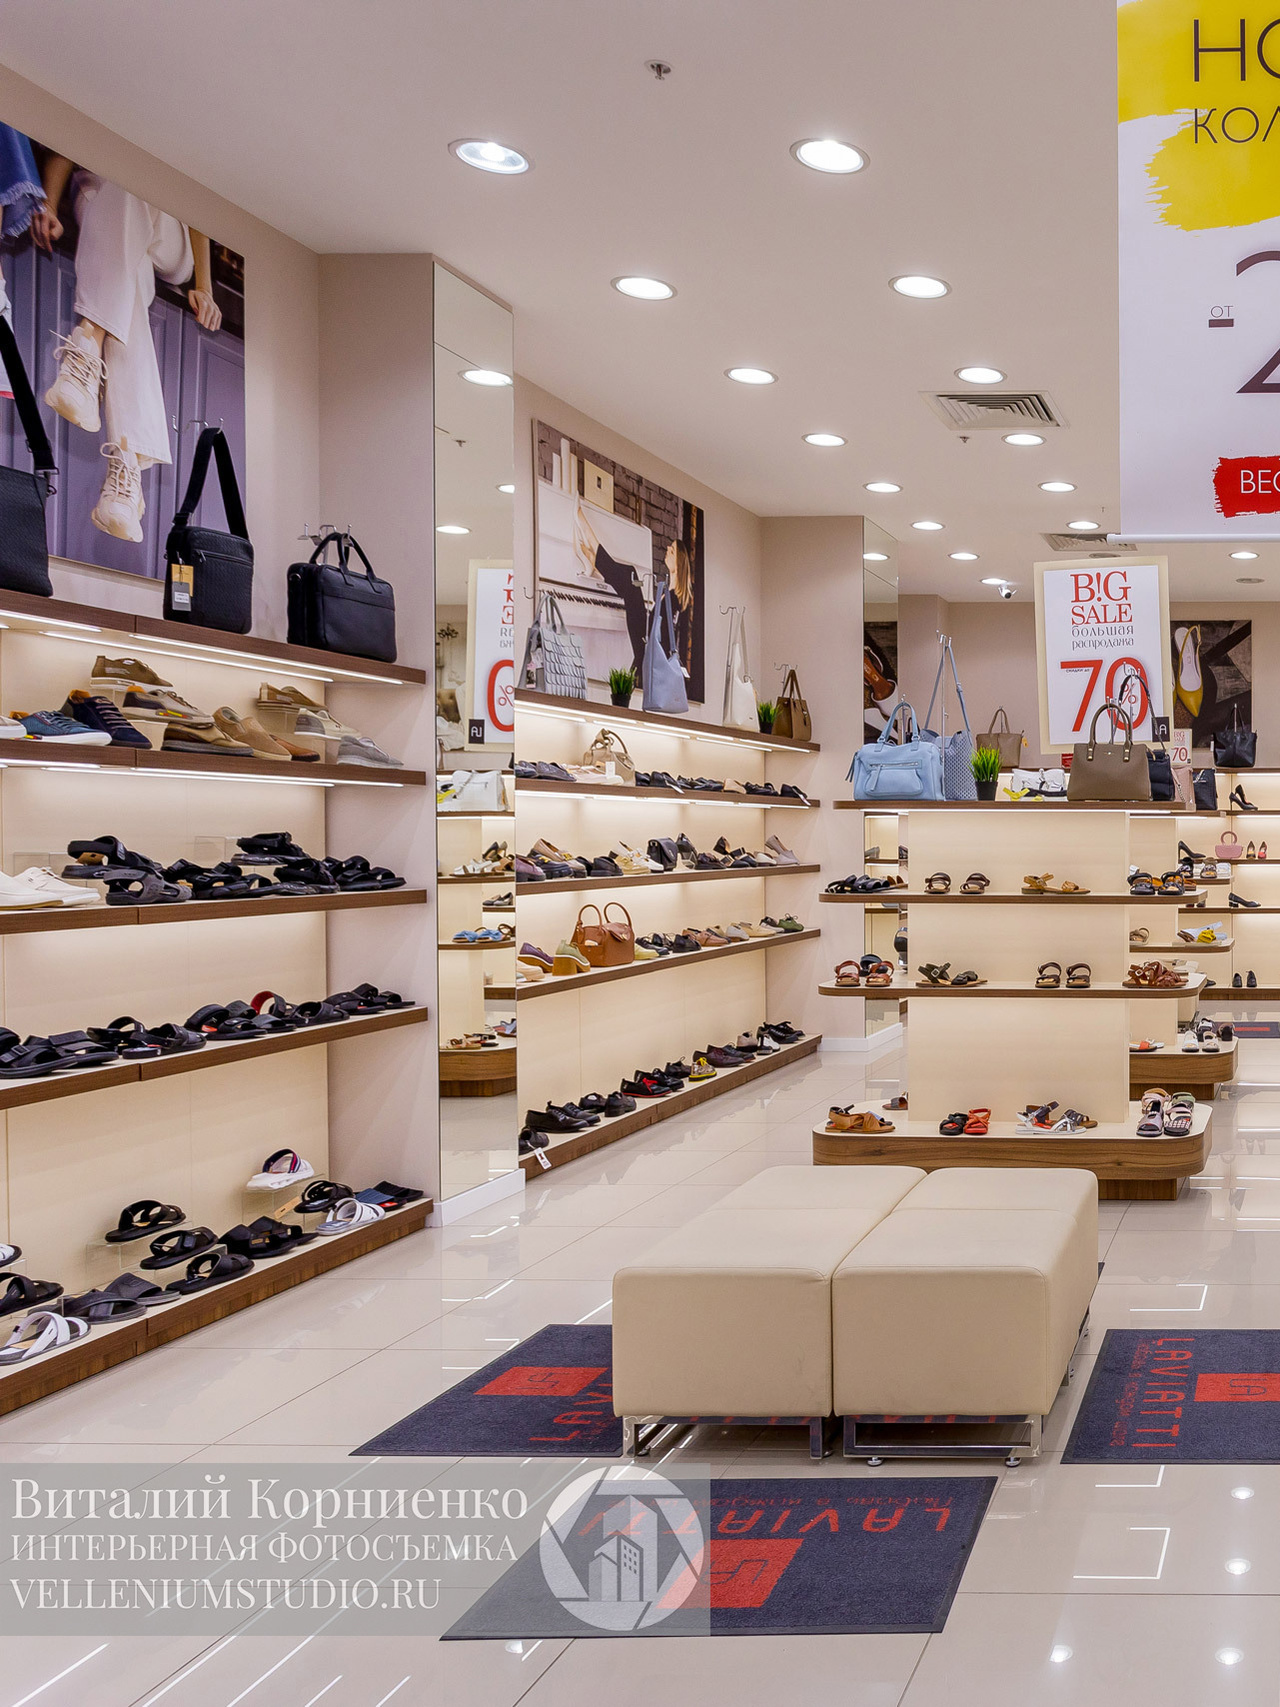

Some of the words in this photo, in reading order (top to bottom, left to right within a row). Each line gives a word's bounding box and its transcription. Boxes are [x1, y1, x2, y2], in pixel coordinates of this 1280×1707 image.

[1070, 603, 1133, 626] SALE
[1071, 625, 1134, 638] большая
[1072, 637, 1135, 652] распродажа
[1060, 656, 1150, 733] 70
[1131, 1337, 1196, 1448] LAVIATTI
